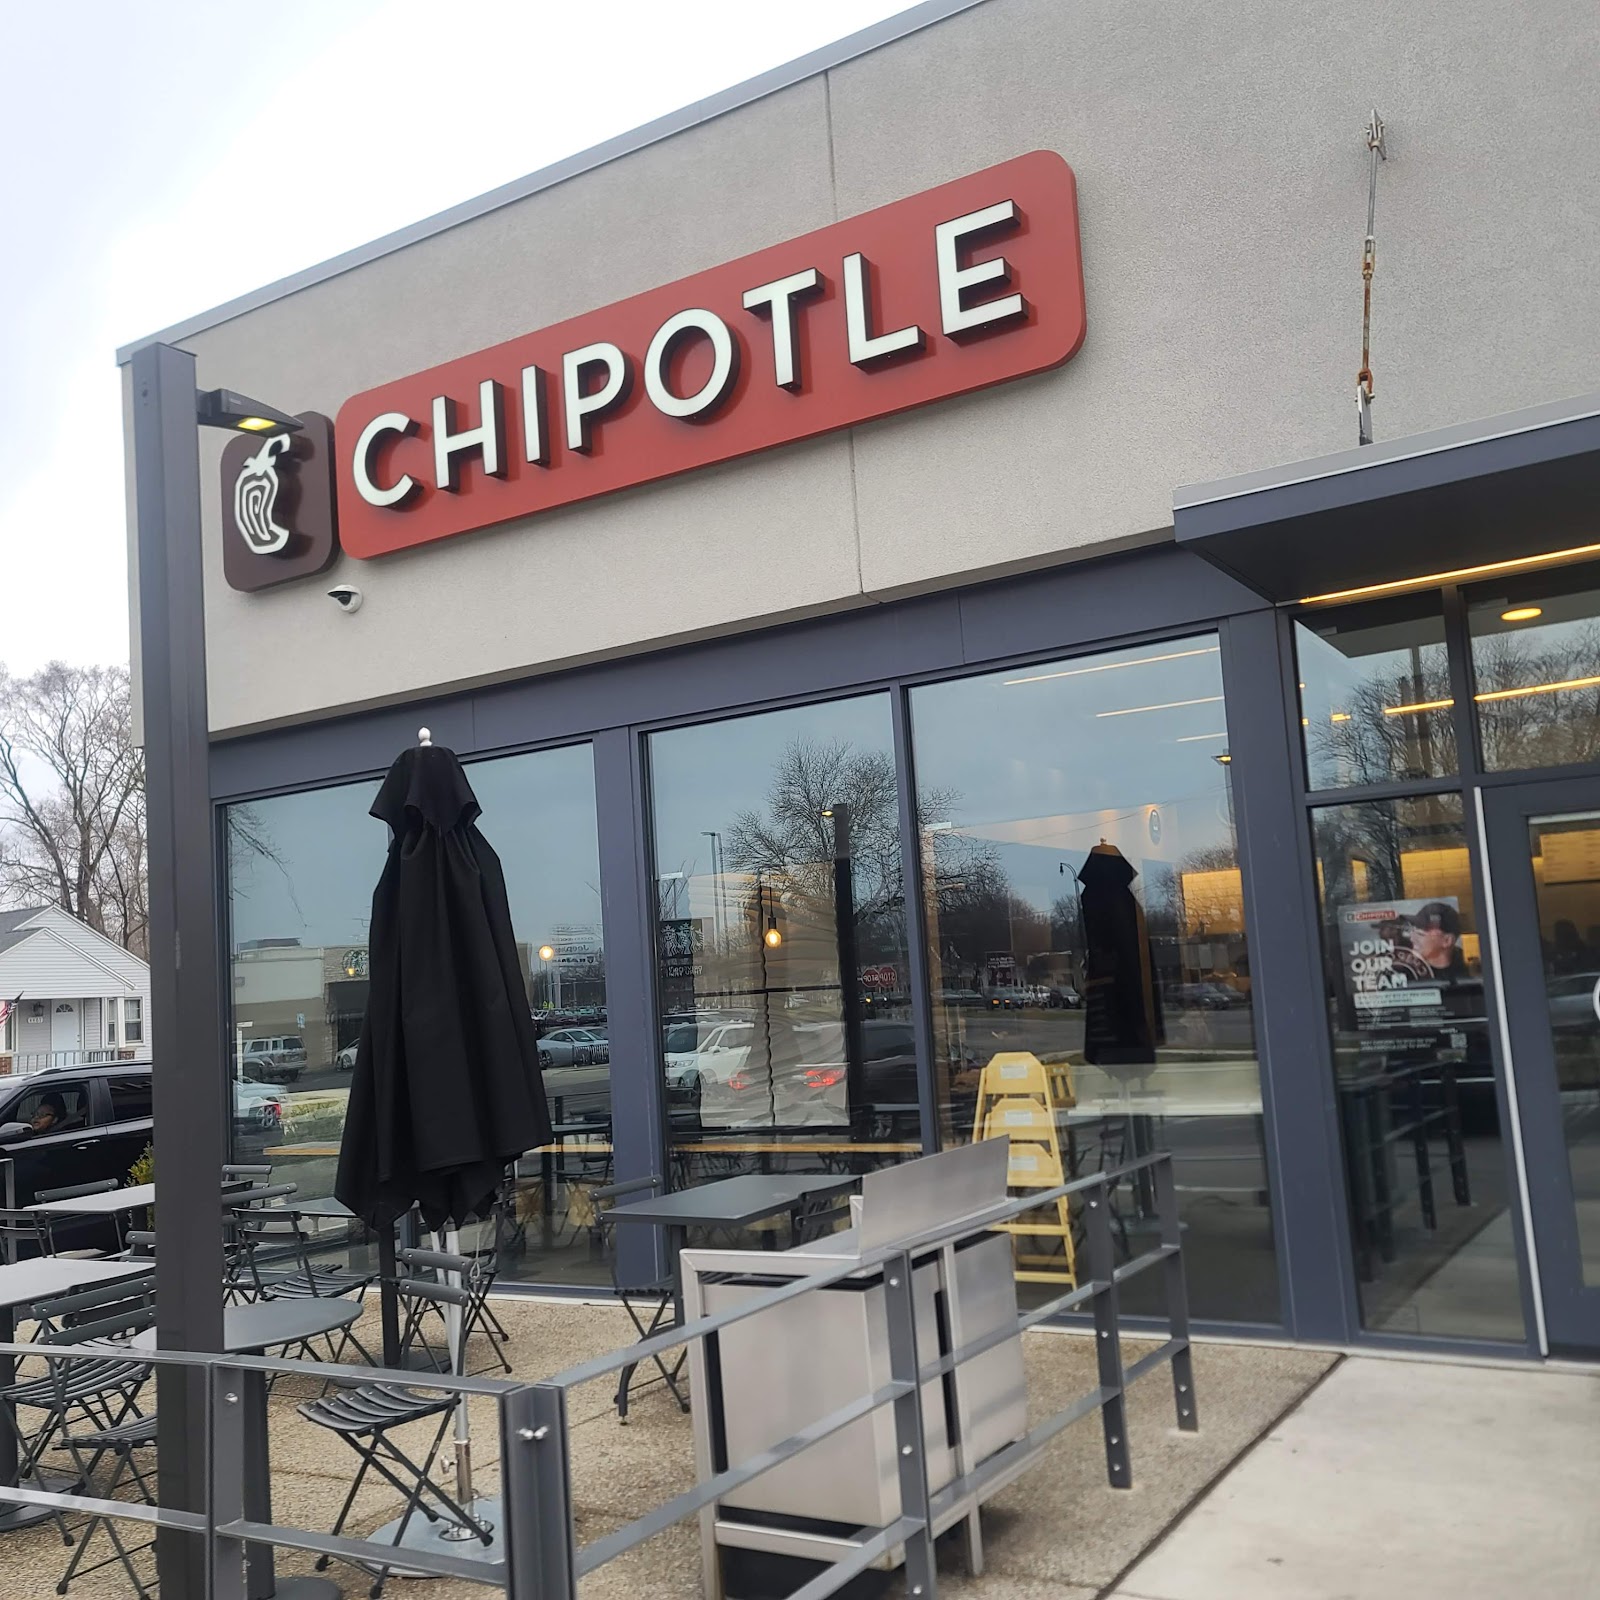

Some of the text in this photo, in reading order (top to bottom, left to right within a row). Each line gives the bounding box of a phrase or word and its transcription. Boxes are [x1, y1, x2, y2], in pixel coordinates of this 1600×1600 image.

[352, 198, 1026, 508] CHIPOTLE
[1349, 939, 1395, 956] JOIN
[1351, 956, 1393, 974] OUR
[1352, 972, 1407, 992] TEAM
